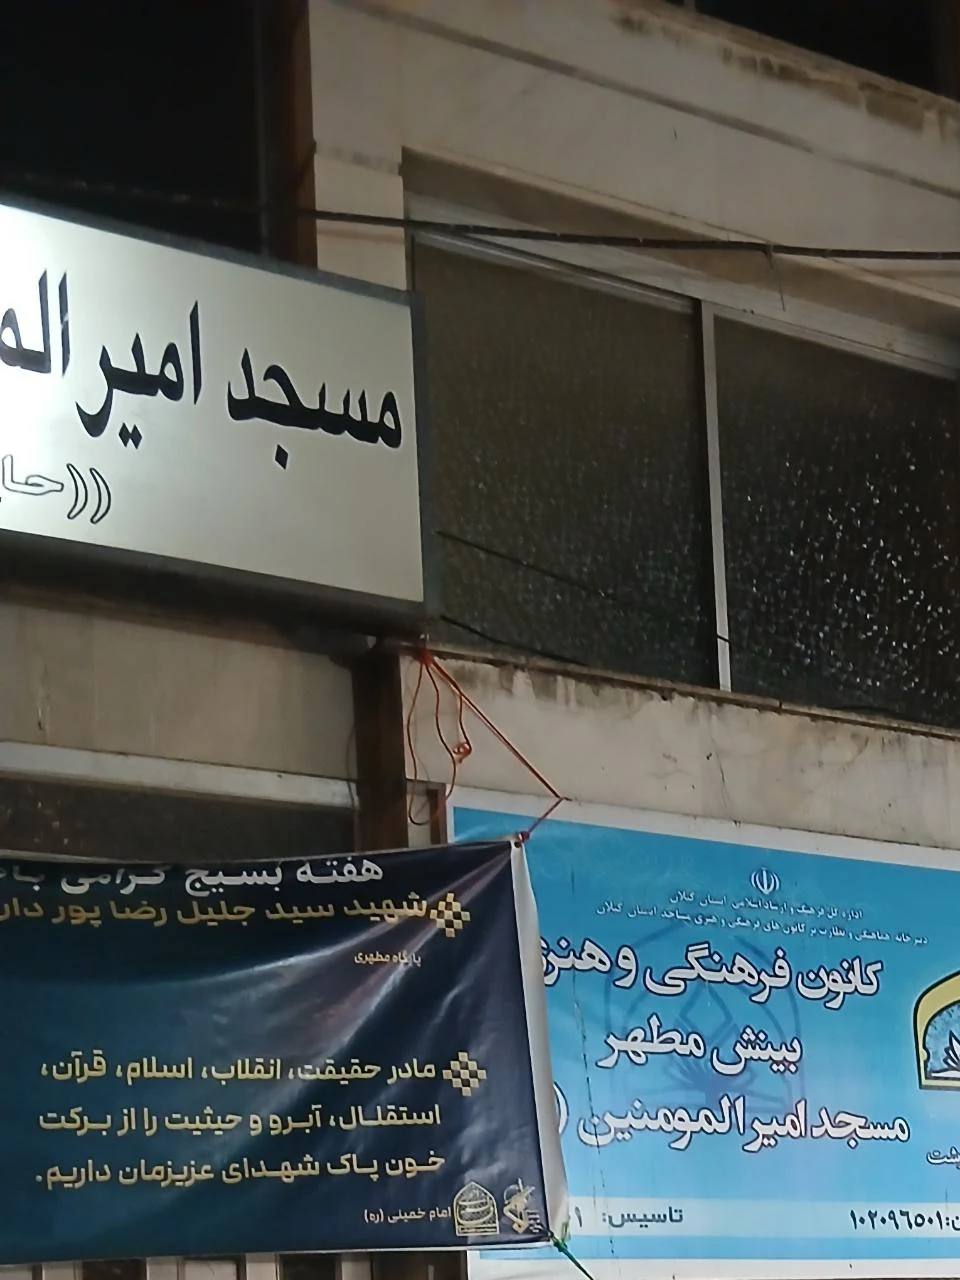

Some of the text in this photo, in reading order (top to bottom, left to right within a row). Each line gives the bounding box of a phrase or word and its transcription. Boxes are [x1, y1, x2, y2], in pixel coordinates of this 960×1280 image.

[75, 300, 202, 450] امیر
[226, 347, 402, 470] مسجد
[185, 863, 283, 899] بسیج
[296, 856, 383, 884] هفته
[51, 904, 102, 928] پور
[109, 900, 168, 928] رضا
[176, 900, 256, 927] جلیل
[265, 901, 335, 924] سید
[343, 891, 428, 924] شهید
[354, 950, 390, 965] مطهری
[540, 936, 883, 1011] کانون فرهنگی و هنر
[596, 1012, 803, 1076] بینش مطهر
[40, 1049, 436, 1086] مادر حقیقت، انقلاب، اسلام، قرآن،
[39, 1103, 441, 1137] استقلال، آبرو و حیثیت را از برکت
[577, 1093, 746, 1151] المومنین
[742, 1097, 807, 1153] امیر
[811, 1106, 911, 1149] مسجد
[35, 1150, 446, 1191] خون پاک شهدای عزیزمان داریم.
[363, 1208, 385, 1225] (ره)
[428, 1206, 451, 1222] امام
[601, 1206, 684, 1229] تاسیس:
